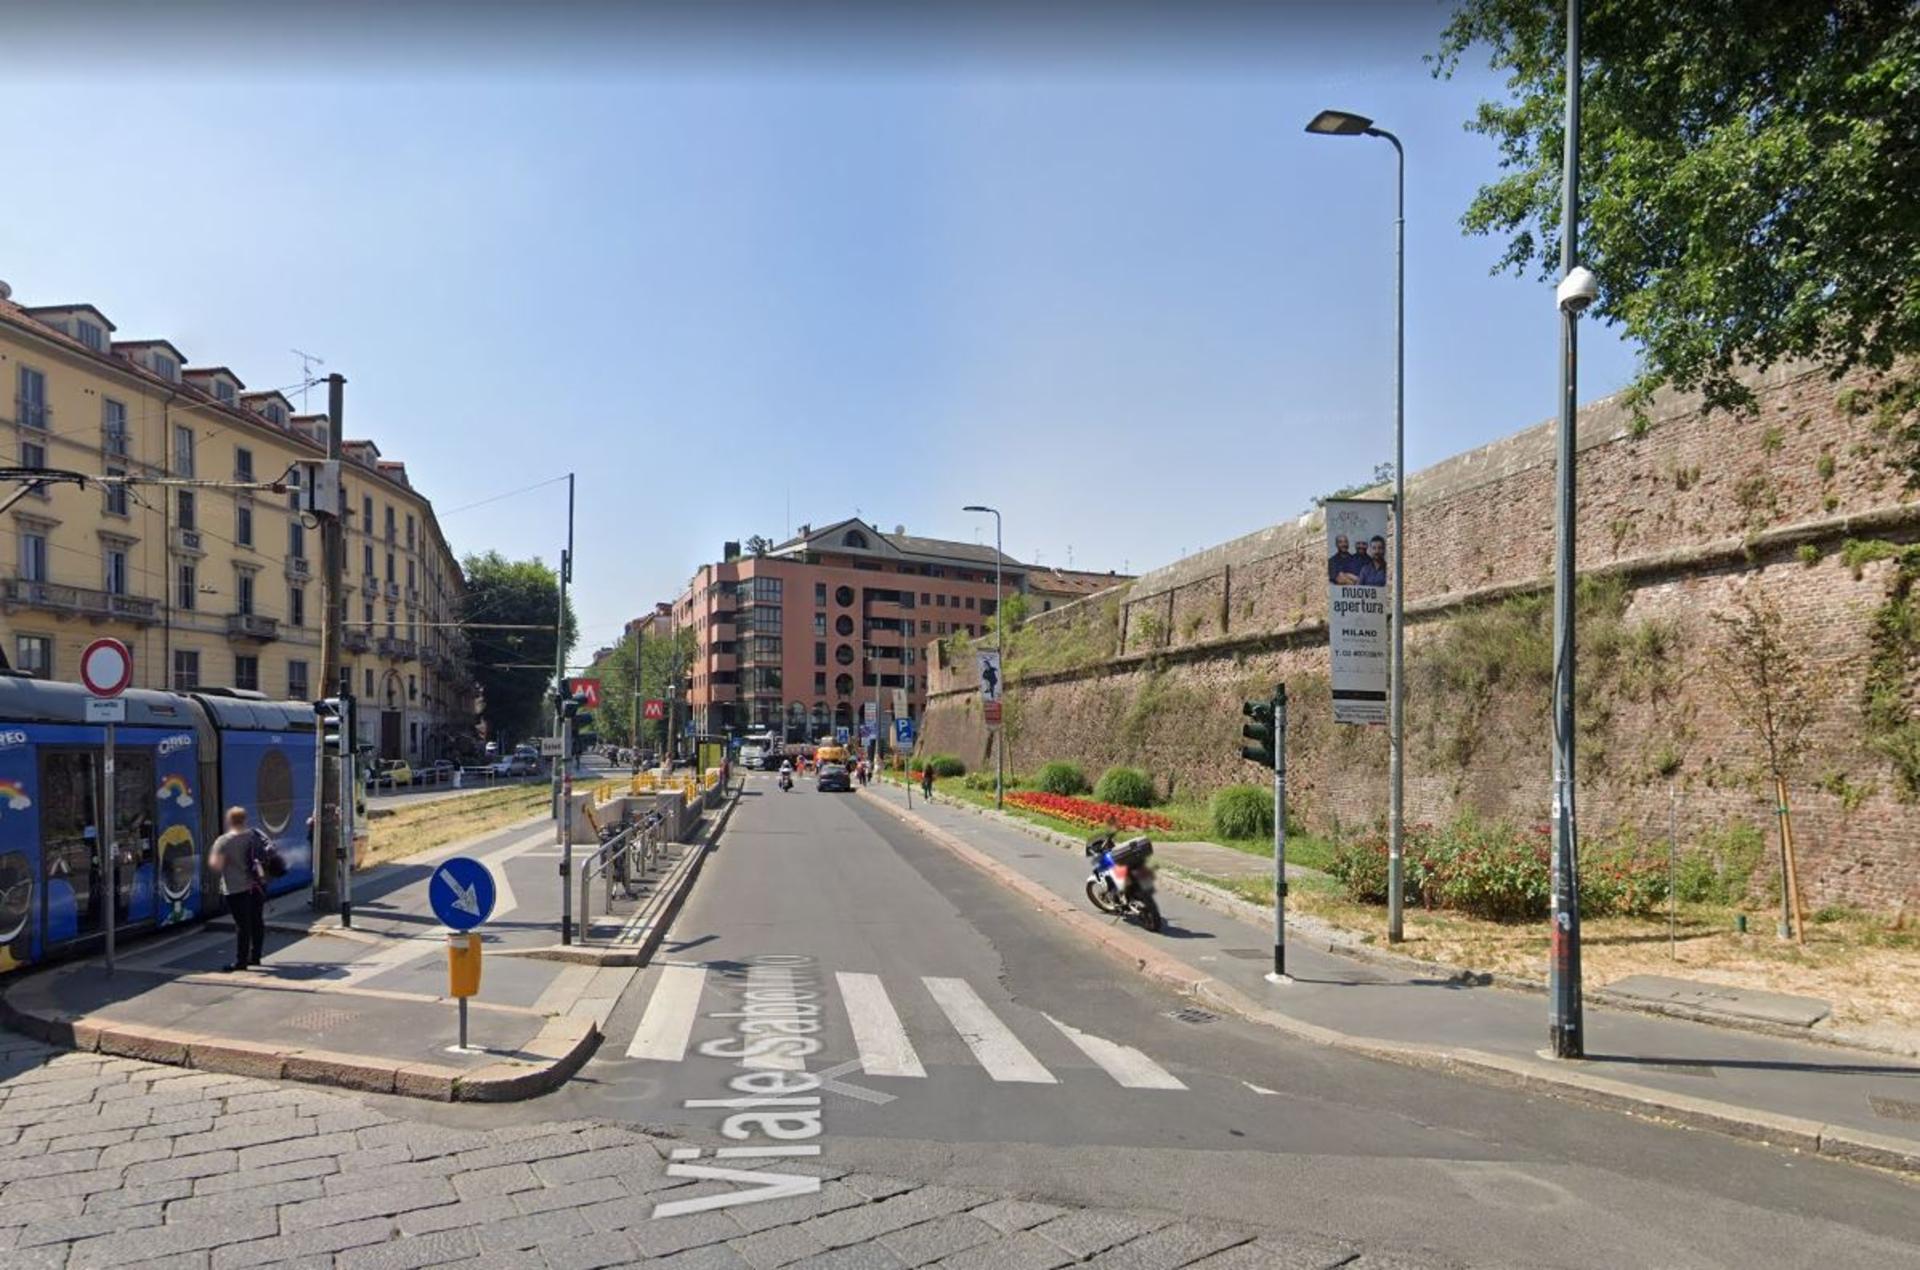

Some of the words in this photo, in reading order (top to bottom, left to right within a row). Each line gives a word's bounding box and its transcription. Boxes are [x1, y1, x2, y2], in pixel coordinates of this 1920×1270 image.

[1342, 587, 1377, 599] nuova
[1334, 599, 1384, 616] apertura
[1342, 629, 1377, 637] MILANO
[645, 703, 661, 716] M
[898, 719, 908, 732] P
[0, 731, 26, 746] REO
